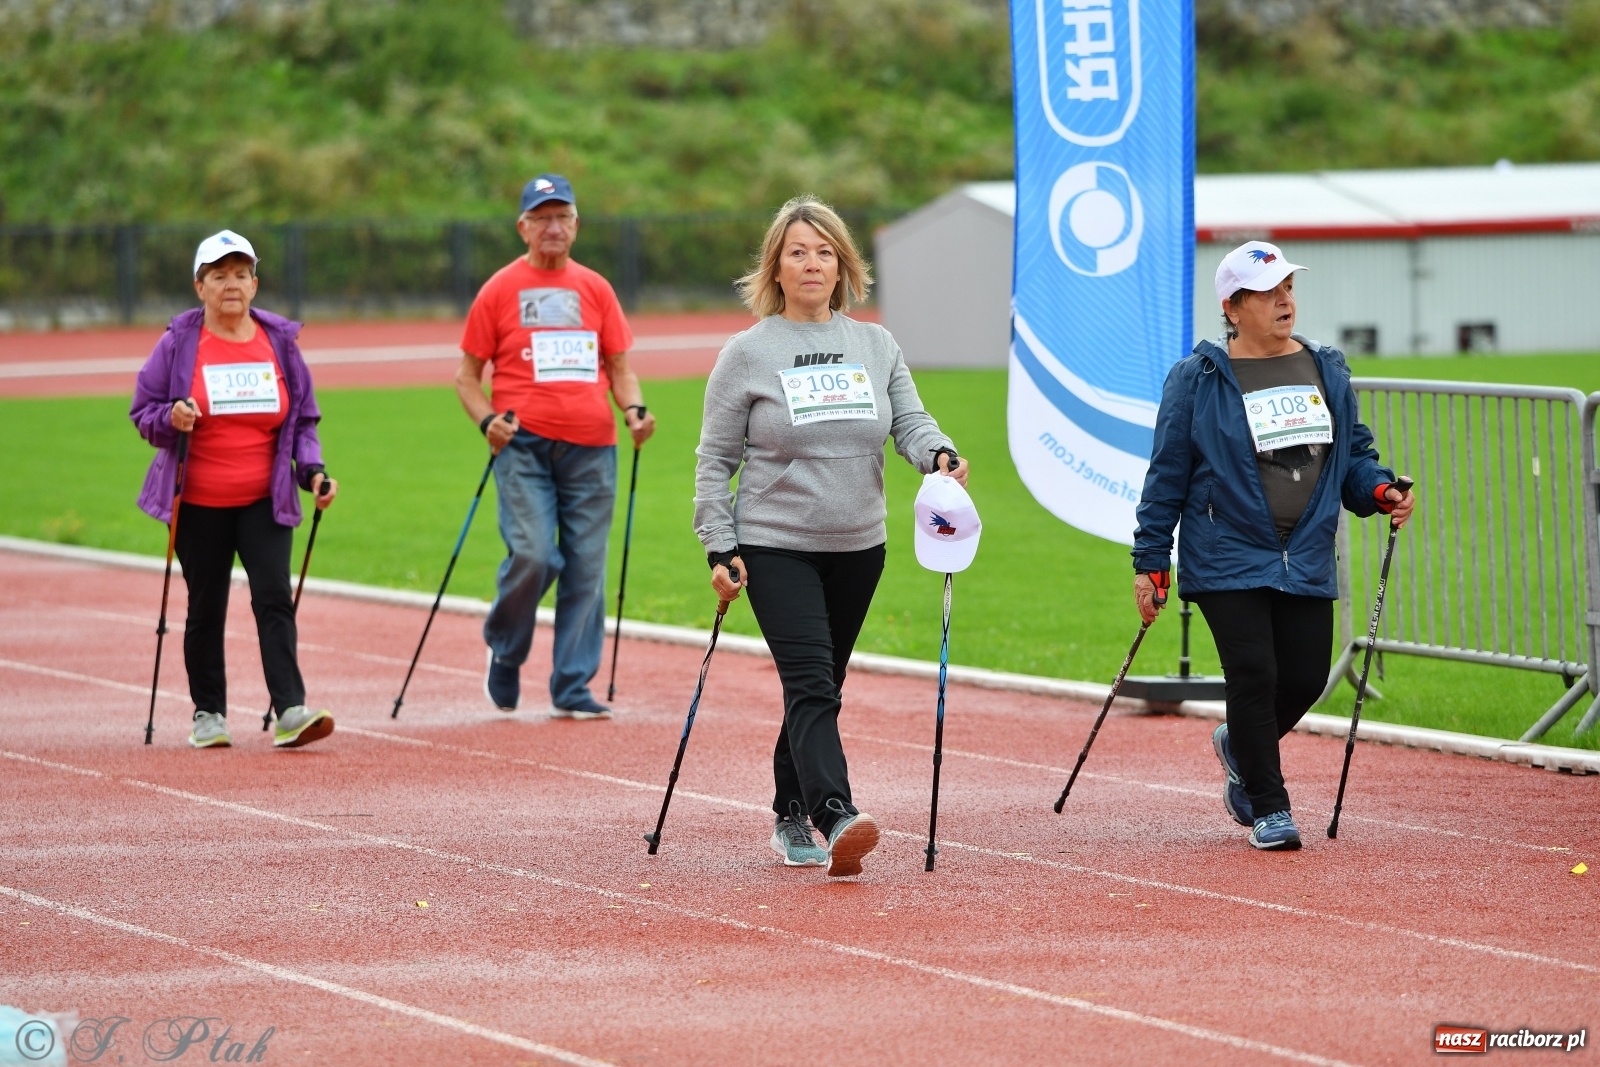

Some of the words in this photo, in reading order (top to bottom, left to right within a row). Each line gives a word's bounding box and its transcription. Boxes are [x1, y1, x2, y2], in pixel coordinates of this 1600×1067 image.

[552, 340, 583, 356] 104
[794, 353, 843, 368] NIKE
[224, 371, 259, 388] 100
[806, 373, 850, 393] 106
[1267, 395, 1308, 417] 108
